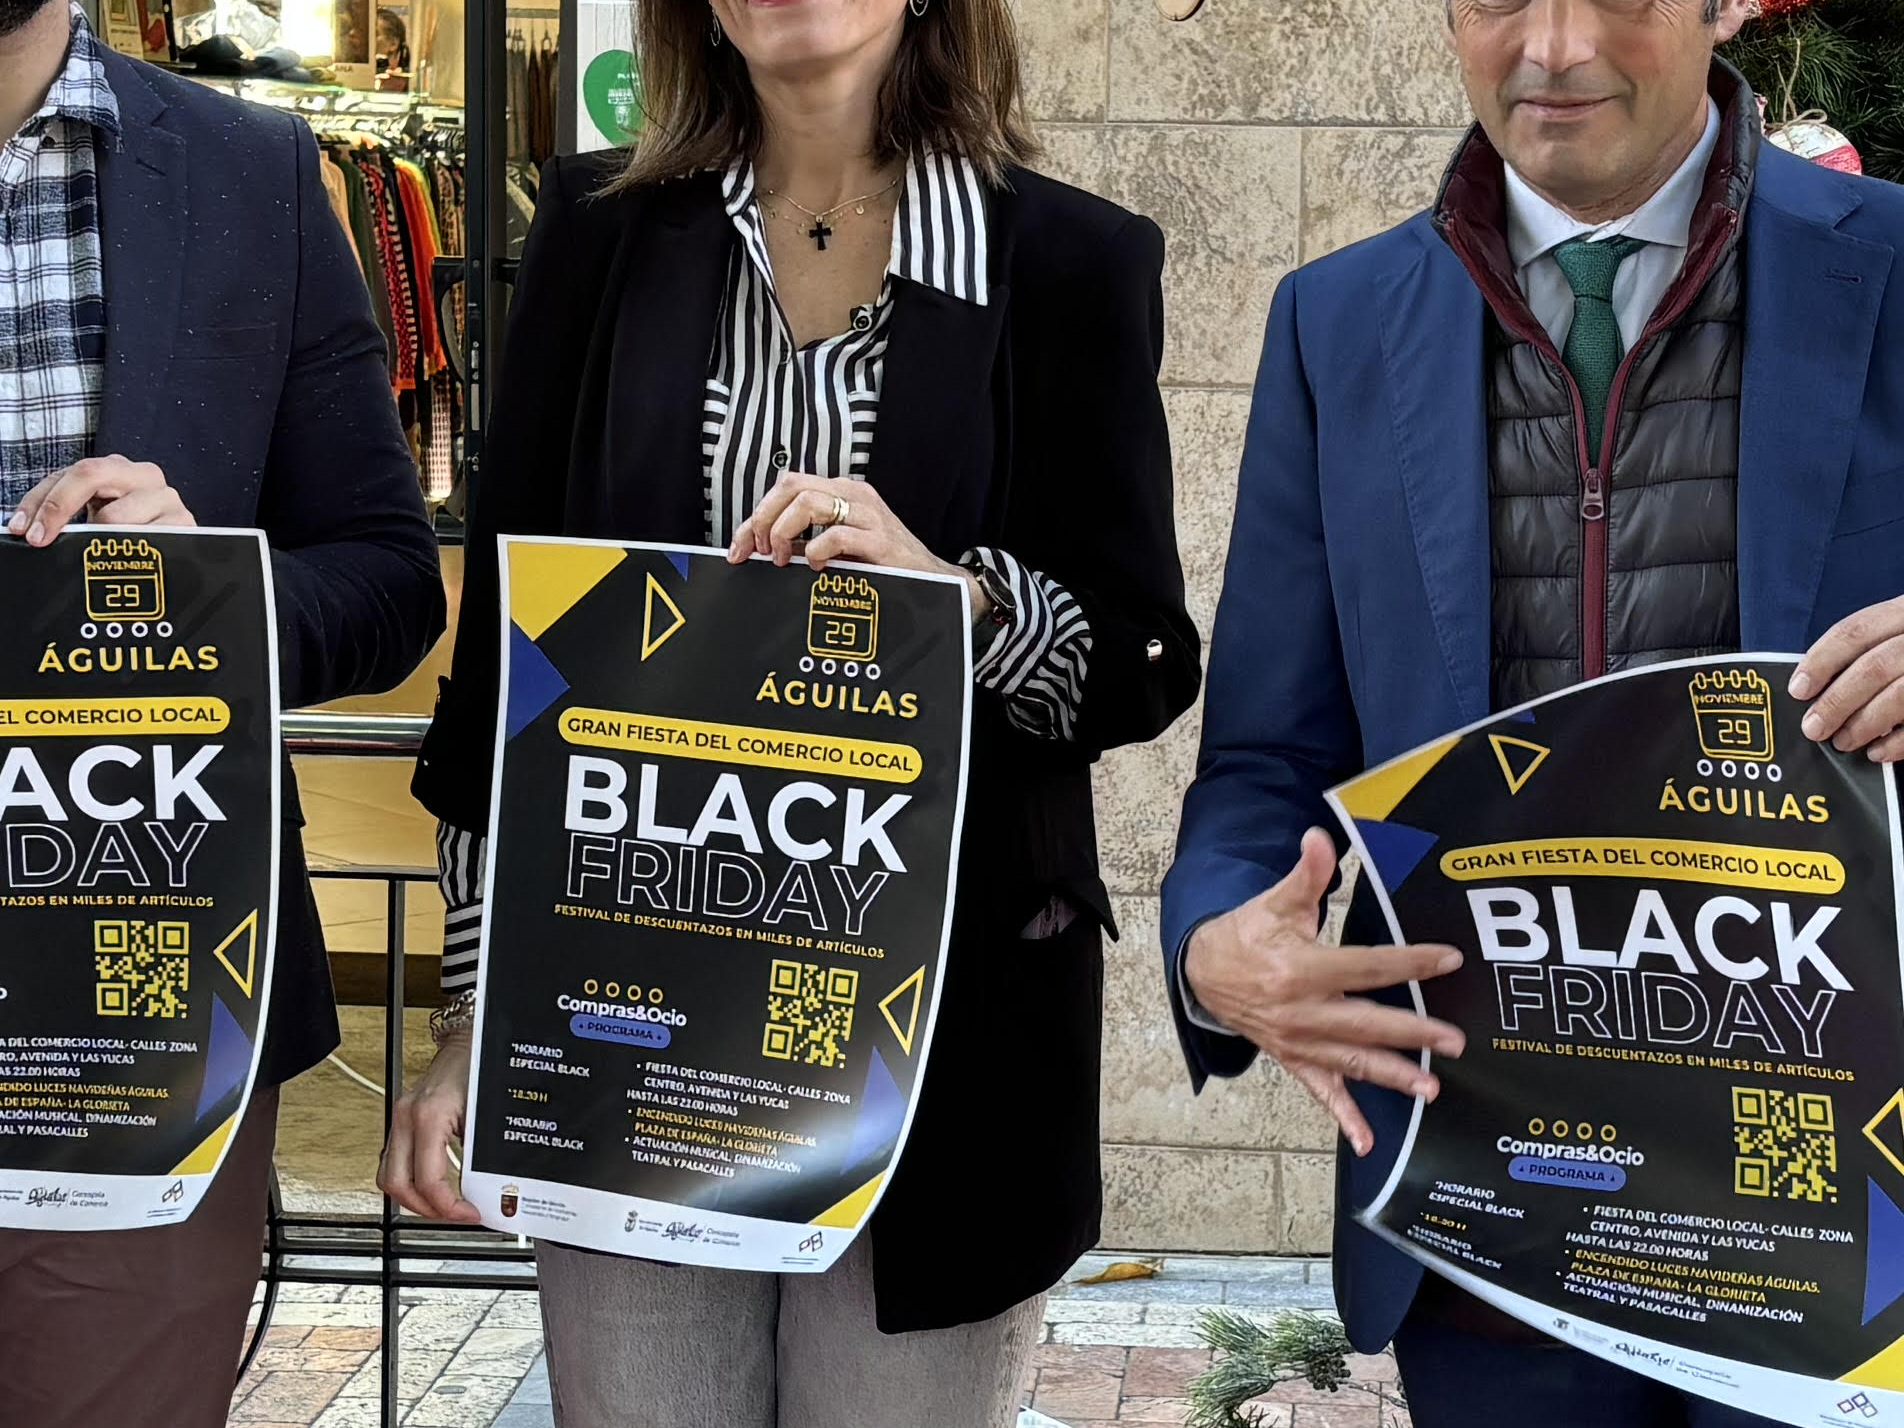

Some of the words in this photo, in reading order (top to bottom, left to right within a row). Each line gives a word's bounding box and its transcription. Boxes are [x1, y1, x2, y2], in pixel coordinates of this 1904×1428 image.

[105, 584, 140, 608] 29
[826, 621, 857, 646] 29
[38, 642, 218, 673] ÁGUILAS
[757, 672, 920, 719] ÁGUILAS
[24, 708, 143, 725] COMERCIO
[150, 707, 222, 723] LOCAL
[1717, 720, 1751, 745] 29
[567, 717, 621, 738] GRAN
[626, 723, 690, 746] FIESTA
[695, 732, 732, 751] DEL
[737, 737, 844, 763] COMERCIO
[849, 749, 913, 772] LOCAL
[565, 755, 912, 873] BLACK
[1660, 779, 1829, 823] ÁGUILAS
[1451, 851, 1517, 872] GRAN
[1521, 848, 1599, 866] FIESTA
[1603, 848, 1647, 865] DEL
[1650, 849, 1759, 875] COMERCIO
[1765, 859, 1836, 882] LOCAL
[49, 895, 69, 906] EN
[72, 895, 114, 905] MILES
[117, 895, 136, 905] DE
[139, 894, 214, 907] ARTÍCULOS
[565, 833, 889, 935] FRIDAY
[554, 903, 611, 921] FESTIVAL
[613, 911, 631, 924] DE
[634, 914, 733, 937] DESCUENTAZOS
[735, 927, 753, 940] EN
[756, 930, 793, 946] MILES
[795, 936, 813, 948] DE
[816, 939, 885, 959] ARTÍCULOS
[1466, 886, 1854, 990] BLACK
[557, 993, 687, 1028] Compras&Ocio
[1493, 963, 1837, 1057] FRIDAY
[1492, 1038, 1552, 1054] FESTIVAL
[1555, 1043, 1573, 1055] DE
[1576, 1045, 1684, 1065] DESCUENTAZOS
[1686, 1054, 1705, 1066] EN
[1709, 1056, 1750, 1071] MILES
[1753, 1060, 1773, 1073] DE
[1776, 1063, 1855, 1082] ARTÍCULOS
[1496, 1136, 1644, 1167] Compras&Ocio
[1529, 1165, 1607, 1182] PROGRAMA
